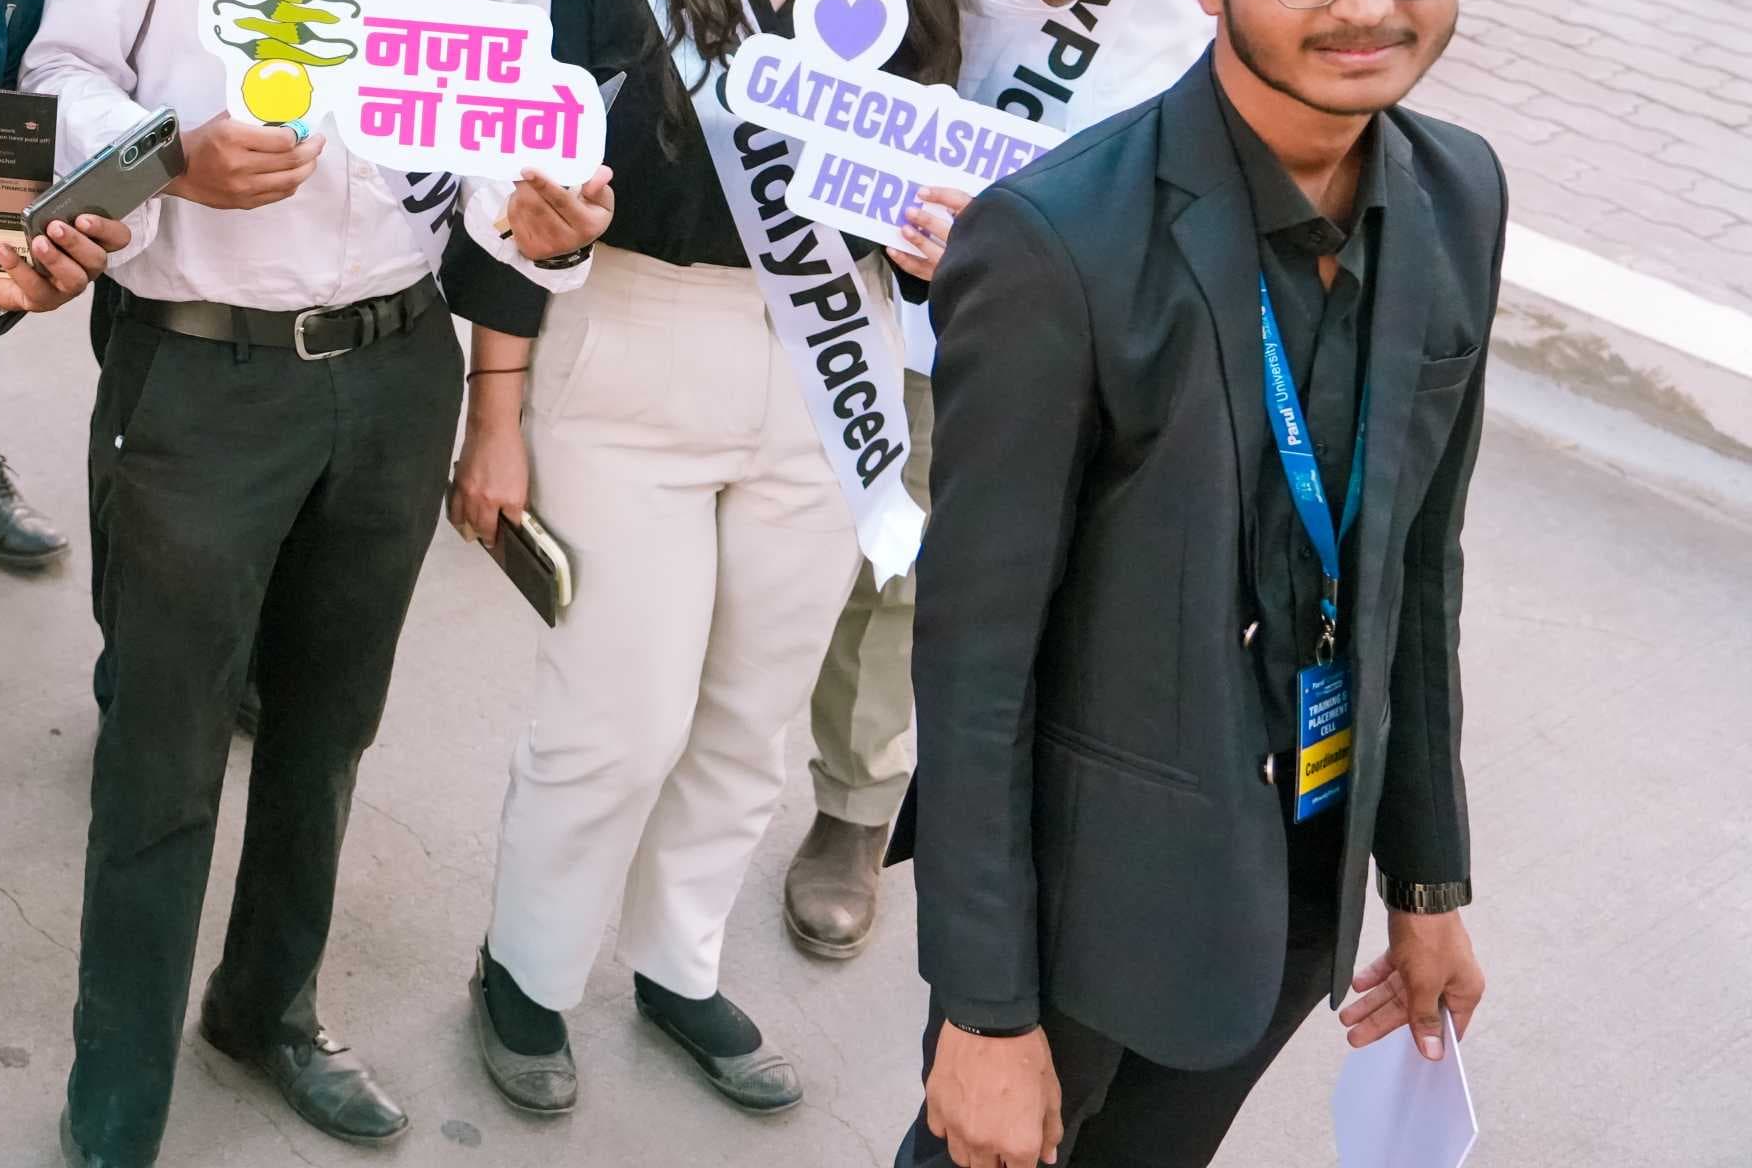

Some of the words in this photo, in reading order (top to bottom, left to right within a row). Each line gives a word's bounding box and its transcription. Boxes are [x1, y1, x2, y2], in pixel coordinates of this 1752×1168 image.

[363, 16, 528, 88] नज़र
[358, 86, 443, 148] ना
[456, 84, 585, 159] लगे
[809, 153, 932, 230] HERE
[1264, 342, 1289, 402] University
[1280, 407, 1302, 446] Parul
[1308, 702, 1348, 730] PLACEMENT
[1309, 694, 1343, 717] TRAINING
[1320, 721, 1337, 737] CELL
